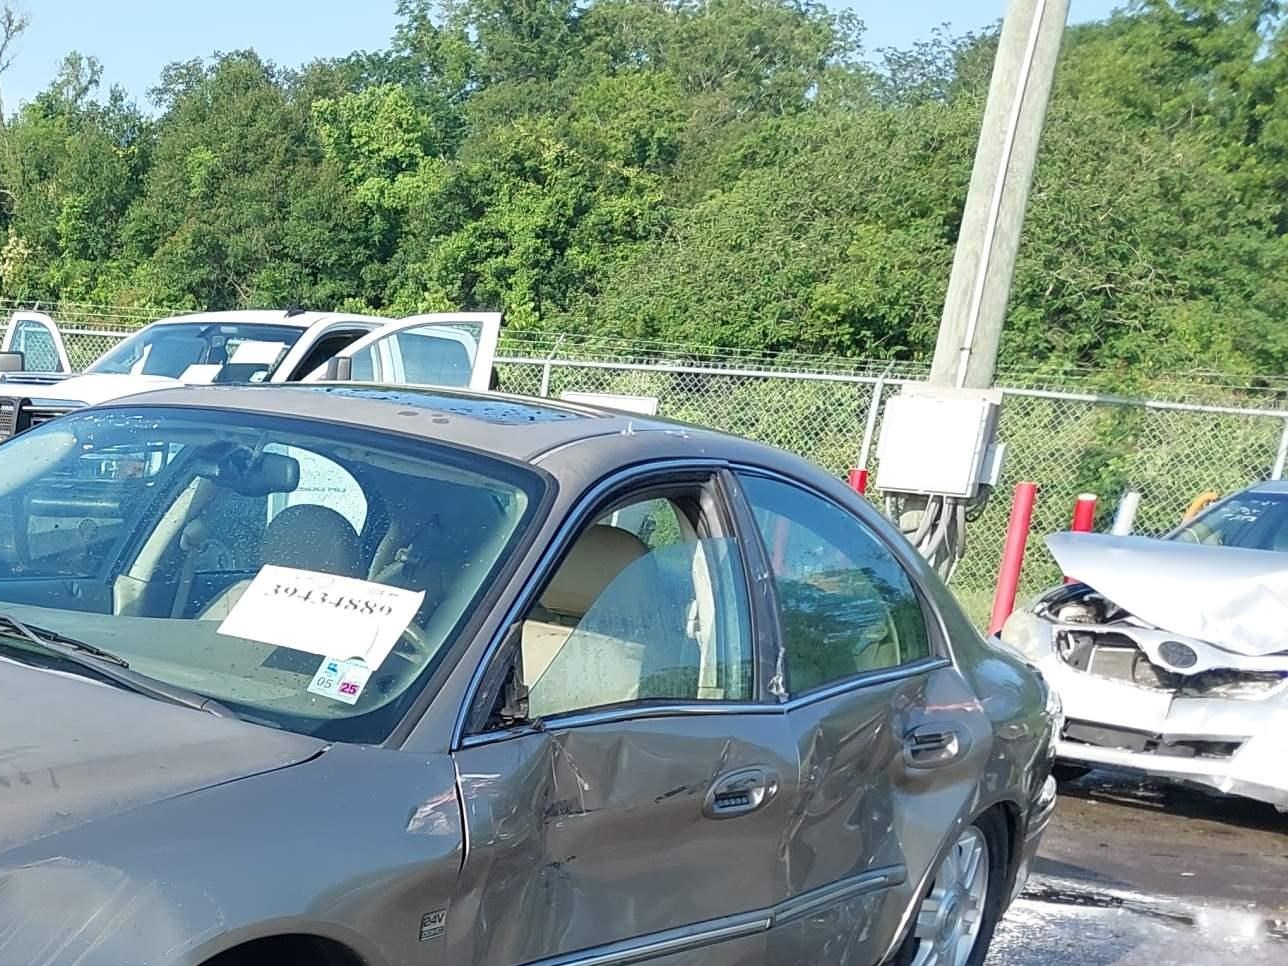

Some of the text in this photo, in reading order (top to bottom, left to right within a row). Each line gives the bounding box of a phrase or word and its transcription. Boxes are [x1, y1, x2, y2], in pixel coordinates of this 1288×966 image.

[316, 676, 334, 689] 05
[340, 681, 360, 695] 25
[423, 911, 445, 927] 24V
